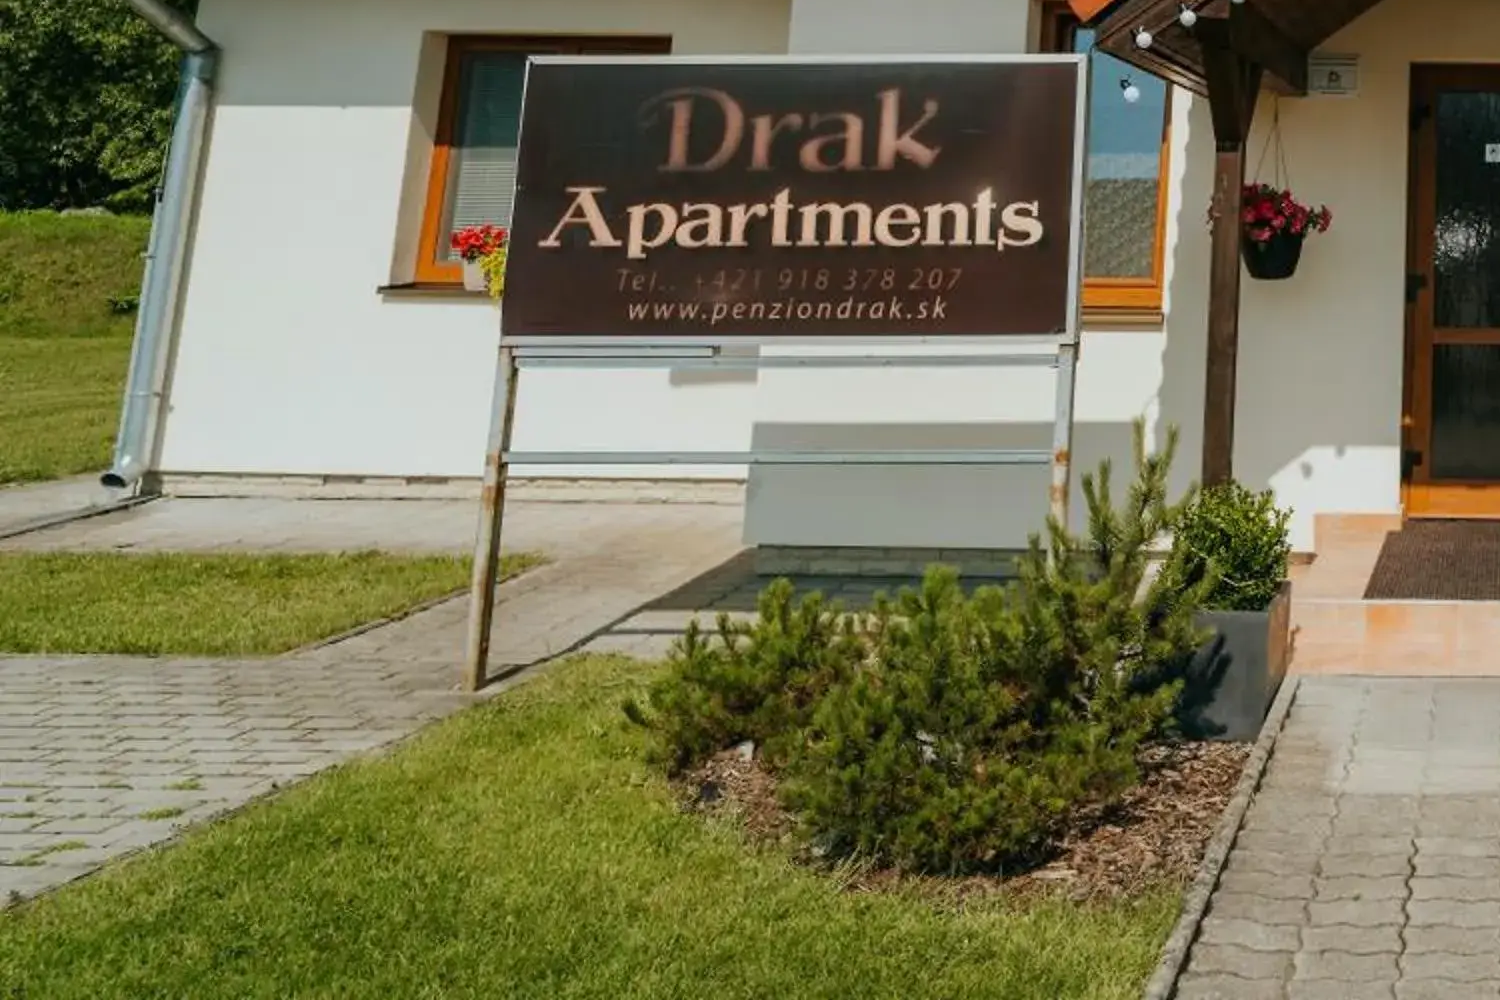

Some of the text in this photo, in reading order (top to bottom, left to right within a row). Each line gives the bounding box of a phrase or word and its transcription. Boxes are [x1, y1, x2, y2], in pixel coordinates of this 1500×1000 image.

[638, 86, 943, 173] Drak
[537, 186, 1045, 259] Apartments
[777, 268, 830, 291] 918
[842, 268, 896, 291] 378
[907, 268, 963, 292] 207
[628, 295, 948, 325] www.penziondrak.sk
